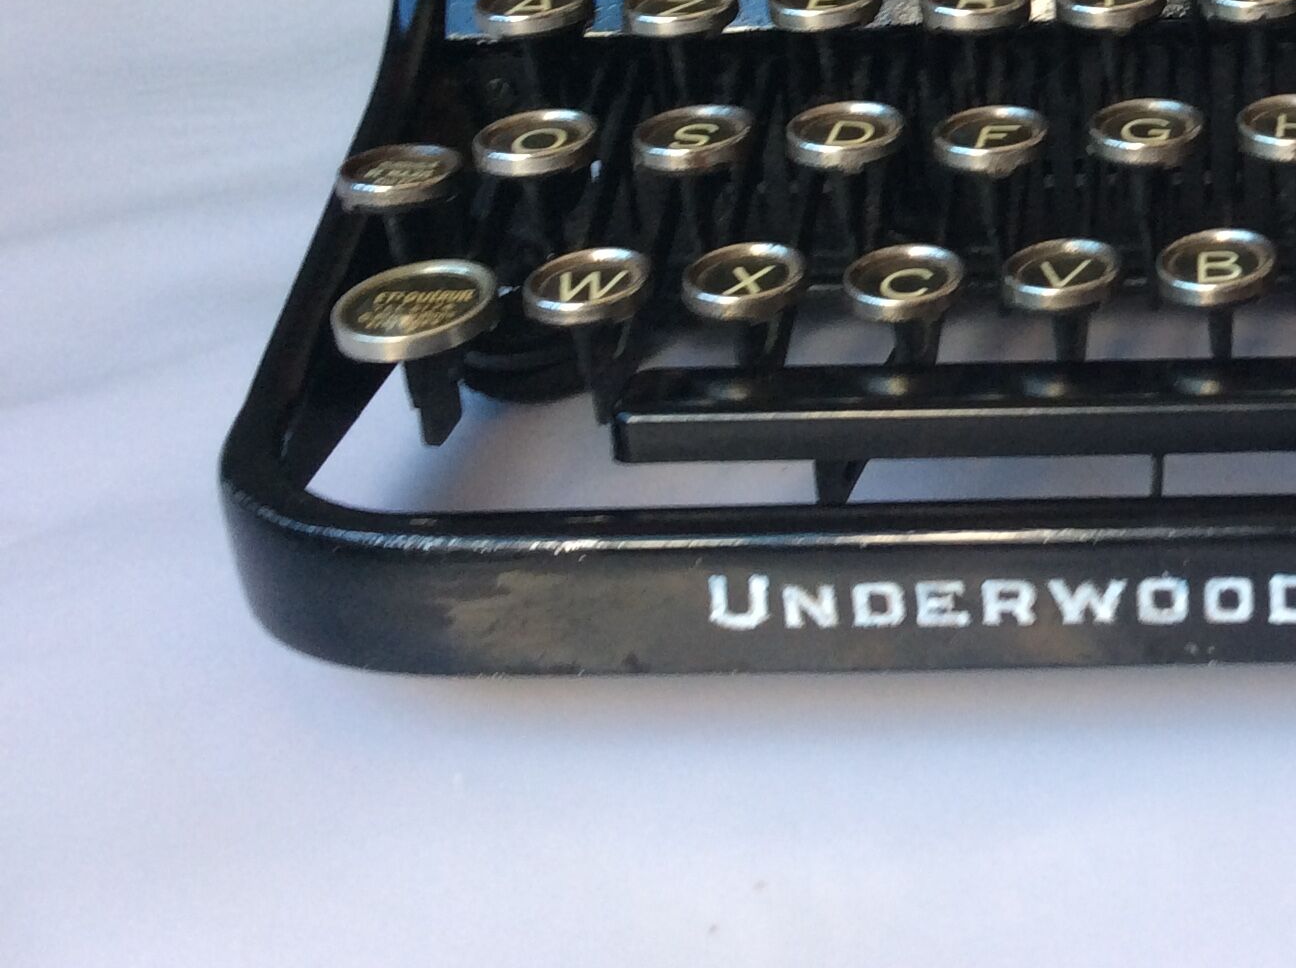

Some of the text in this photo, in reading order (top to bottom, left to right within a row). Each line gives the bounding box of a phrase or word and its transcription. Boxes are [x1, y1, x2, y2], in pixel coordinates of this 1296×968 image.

[667, 123, 720, 150] S
[825, 120, 876, 146] D
[974, 125, 1022, 150] F
[1120, 117, 1173, 144] G
[721, 264, 777, 297] X
[1039, 259, 1093, 289] V
[1197, 250, 1244, 285] B
[557, 269, 630, 302] W
[878, 267, 936, 300] C
